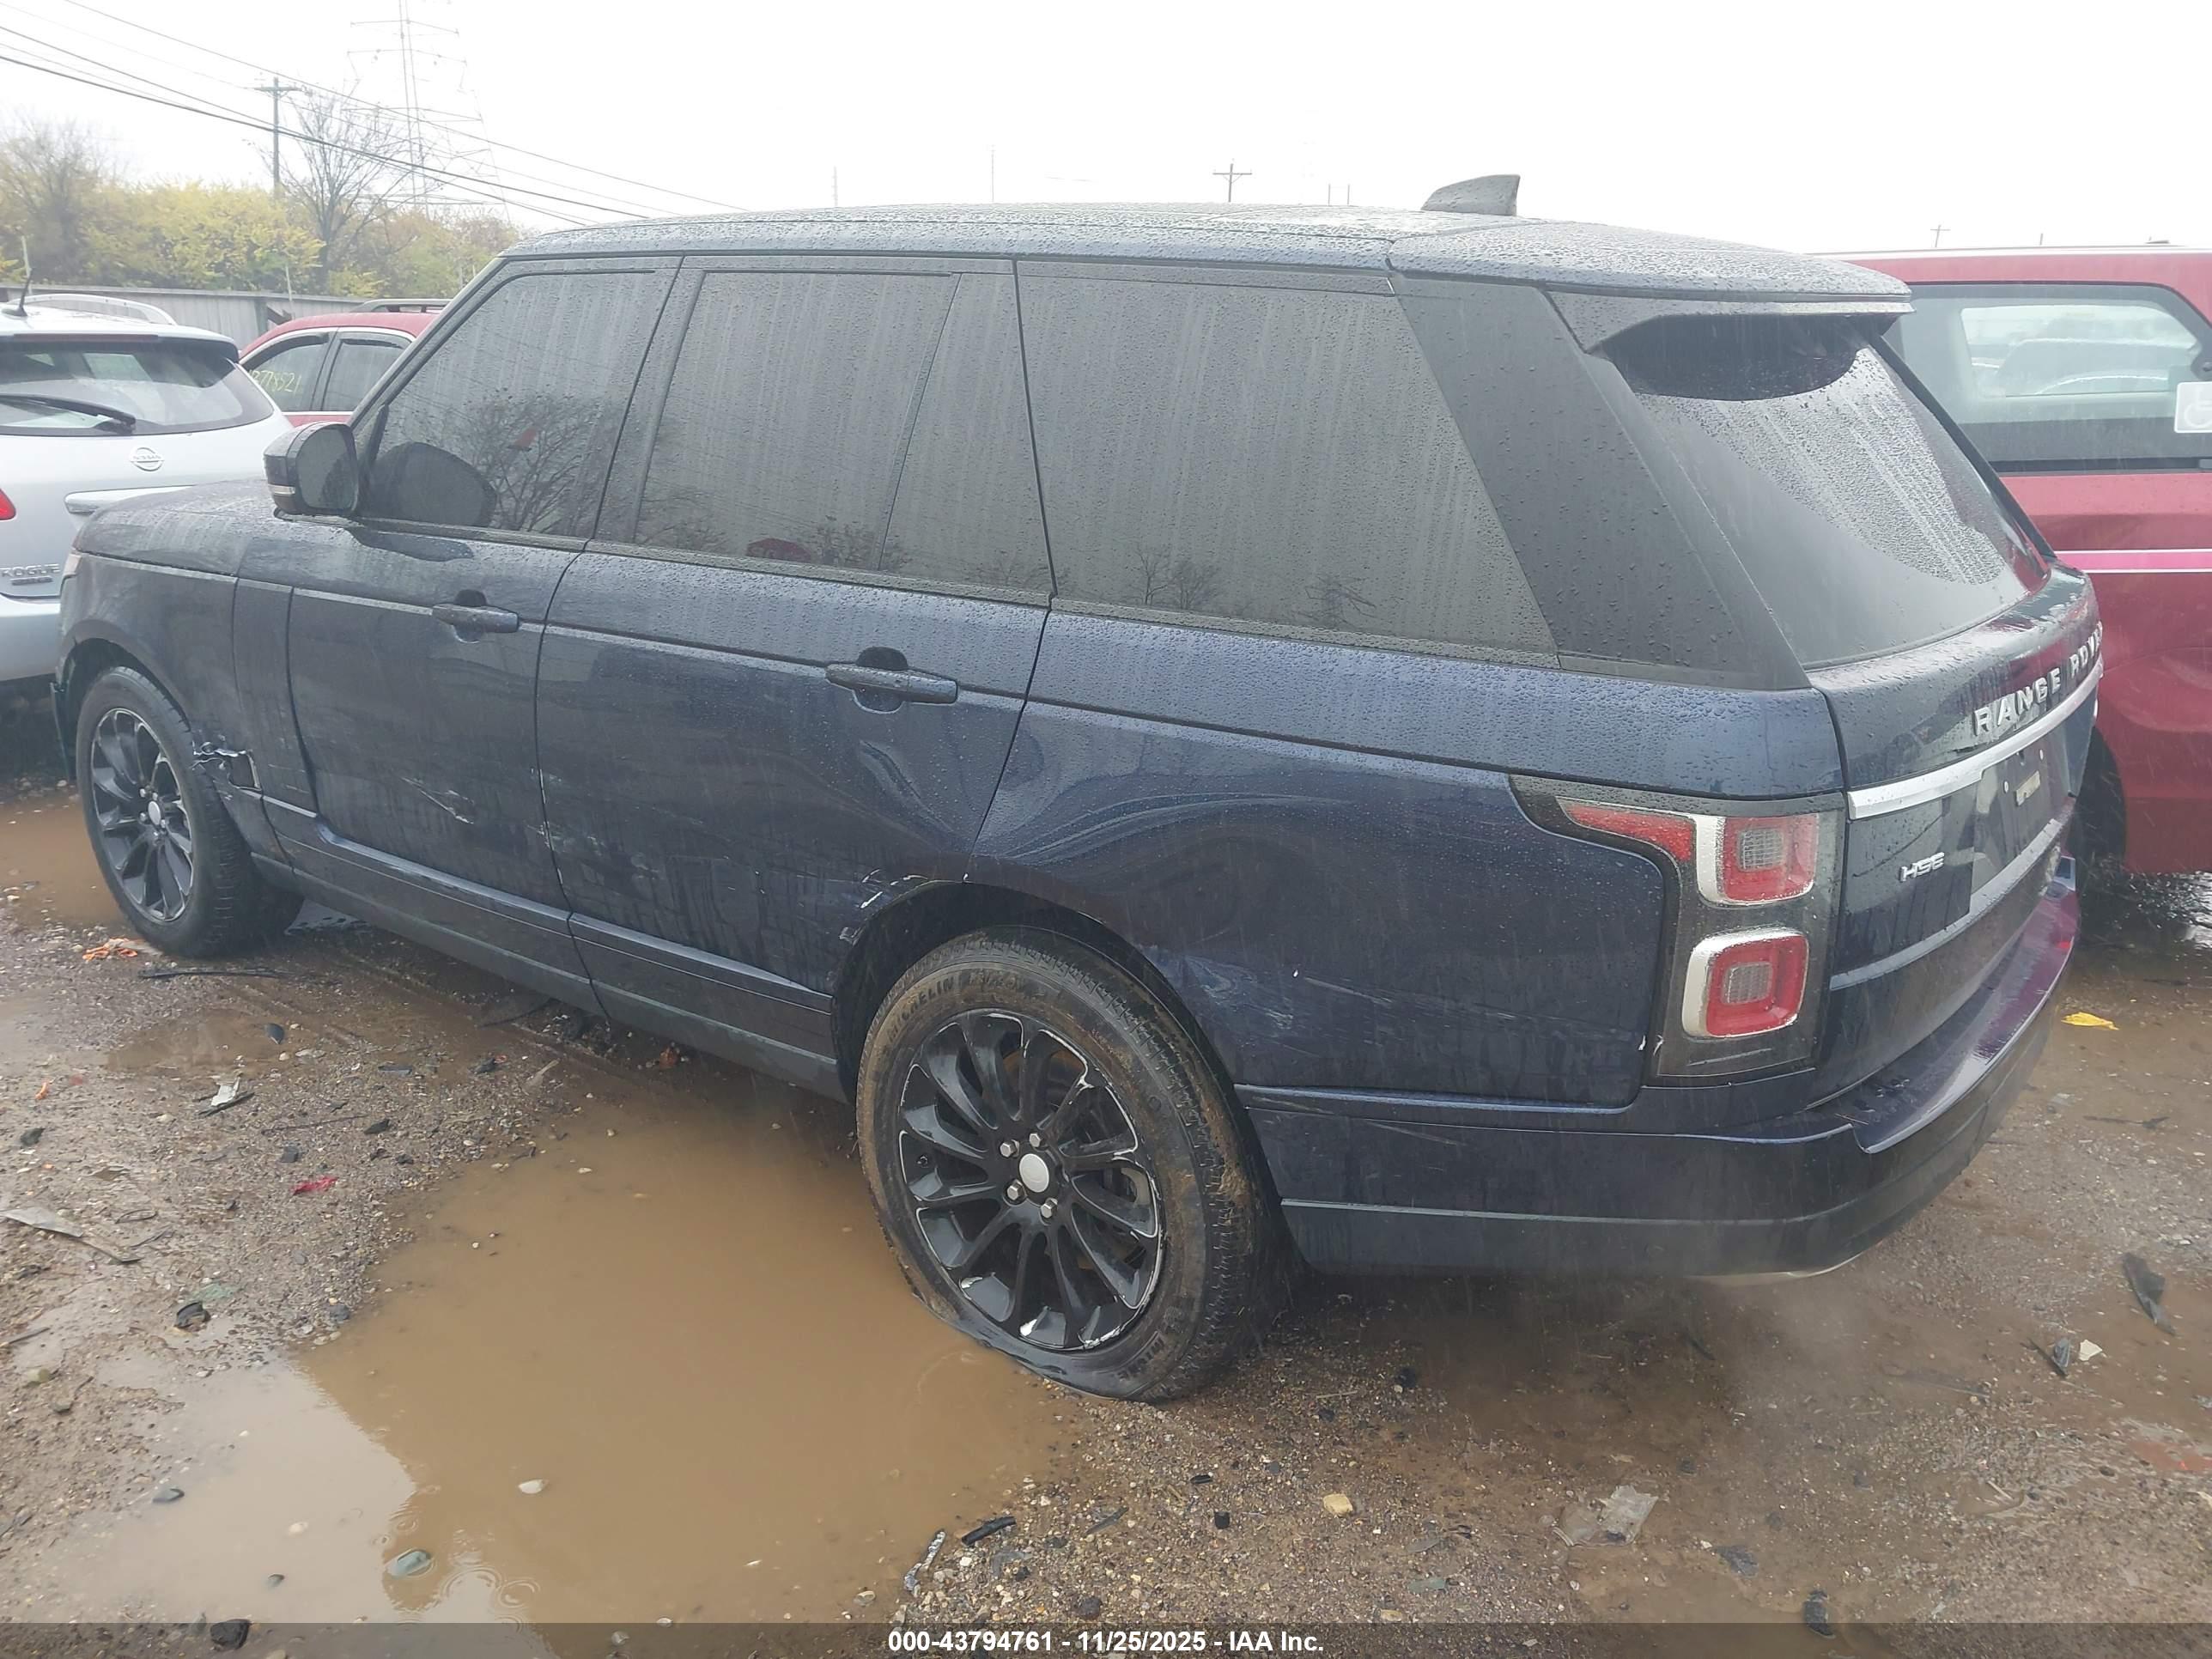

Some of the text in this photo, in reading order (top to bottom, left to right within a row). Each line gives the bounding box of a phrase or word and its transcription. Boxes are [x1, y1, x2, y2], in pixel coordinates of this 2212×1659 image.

[0, 563, 60, 577] ROGUE
[1973, 667, 2061, 736] RANGE
[1899, 851, 1945, 883] HSE
[885, 975, 956, 1042] MICHELIN
